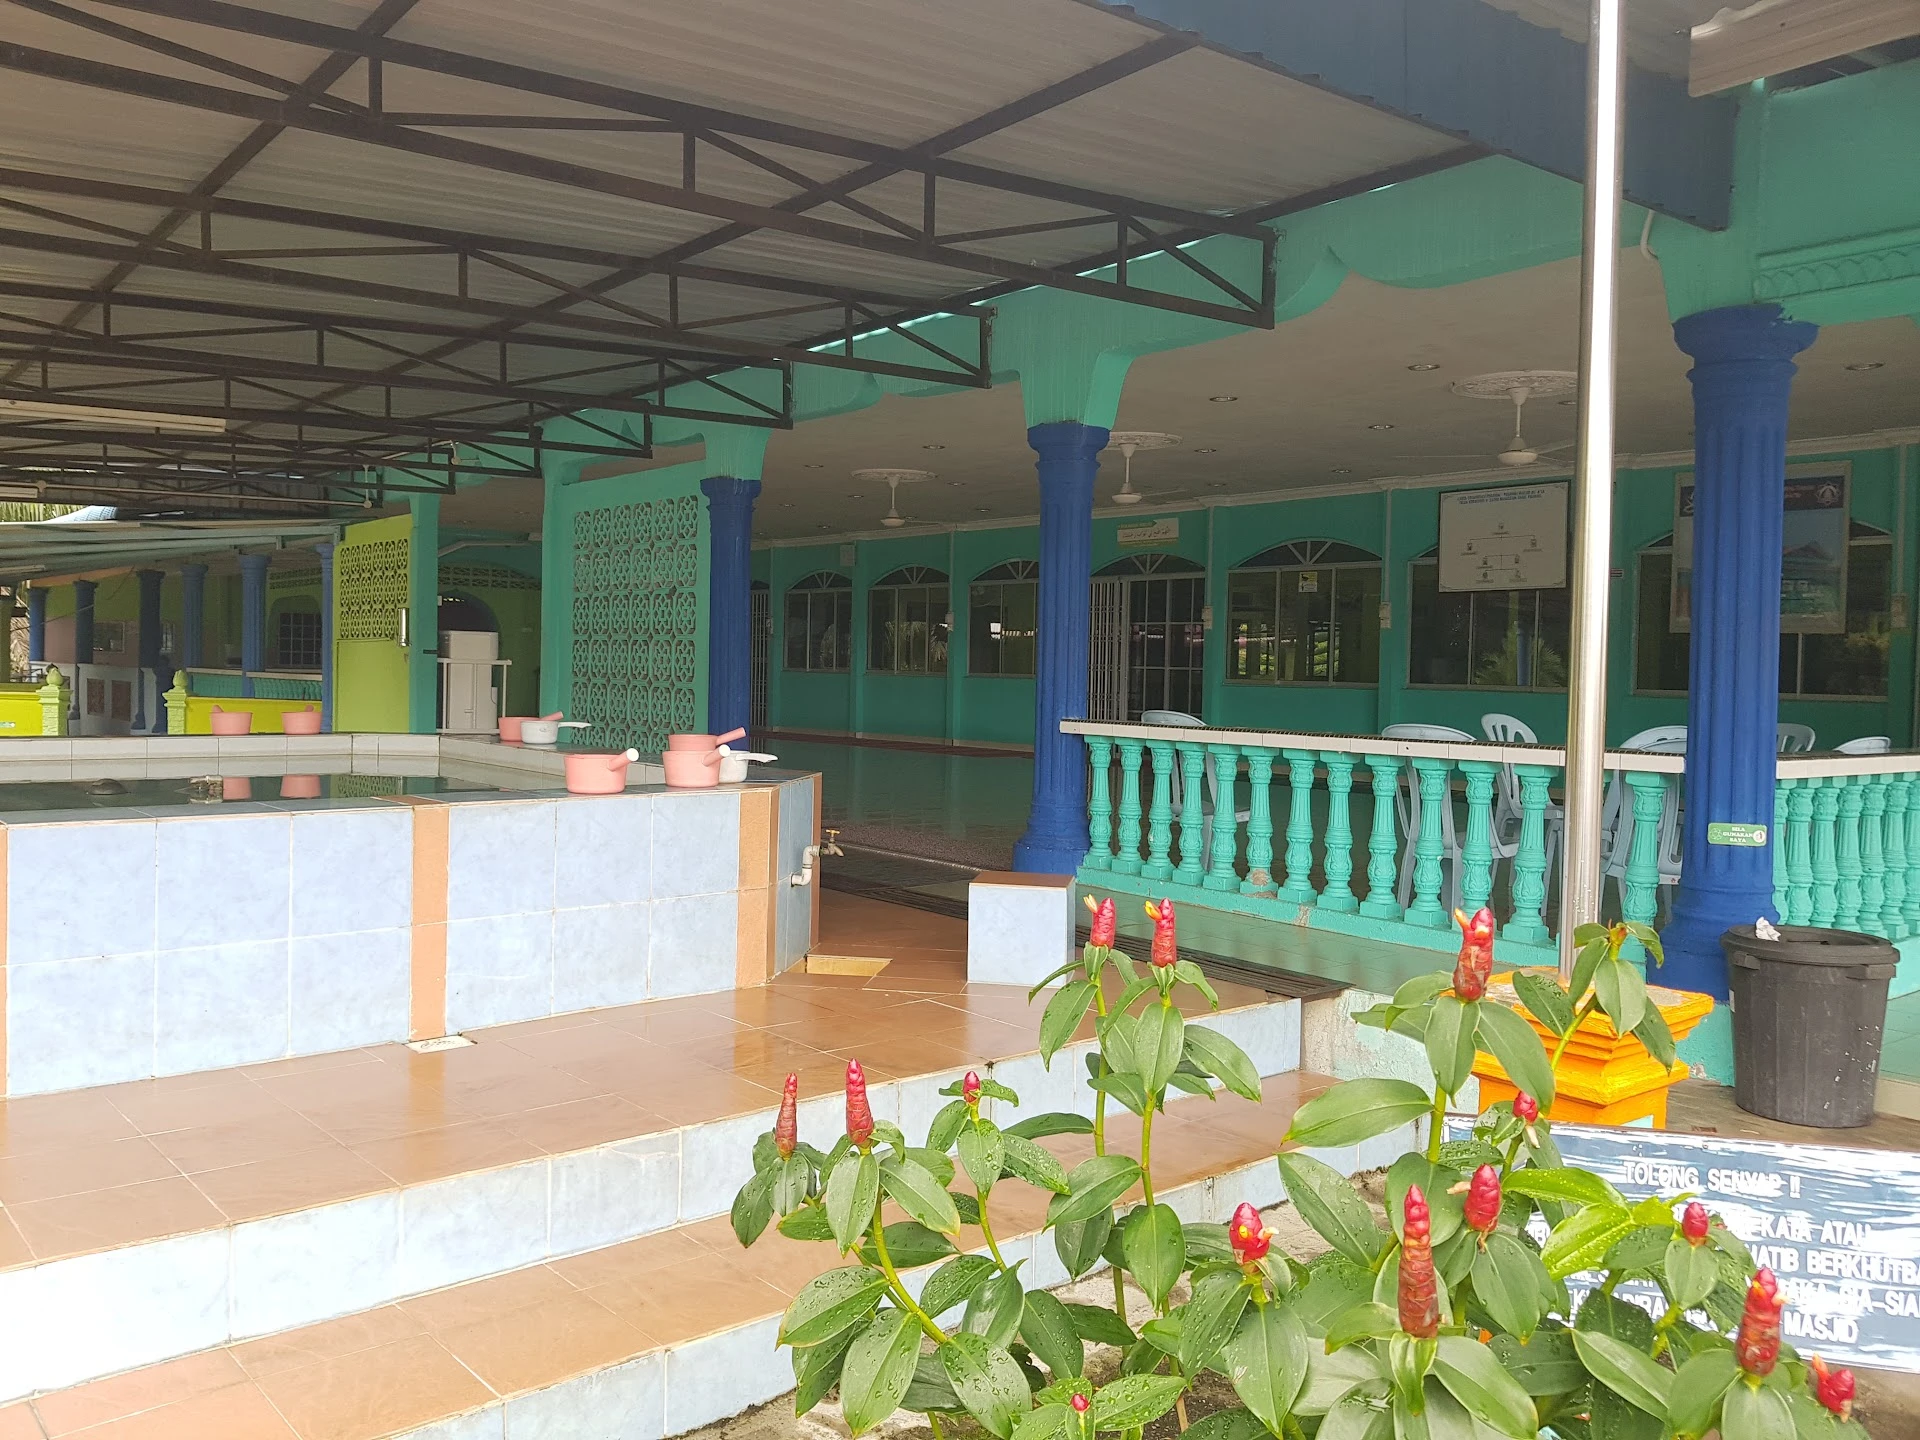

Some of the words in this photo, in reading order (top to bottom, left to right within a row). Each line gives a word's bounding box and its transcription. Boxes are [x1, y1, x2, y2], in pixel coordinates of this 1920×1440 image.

[1623, 1161, 1700, 1190] TOLONG
[1707, 1167, 1782, 1198] SENYAP
[1783, 1311, 1860, 1344] MASJID
